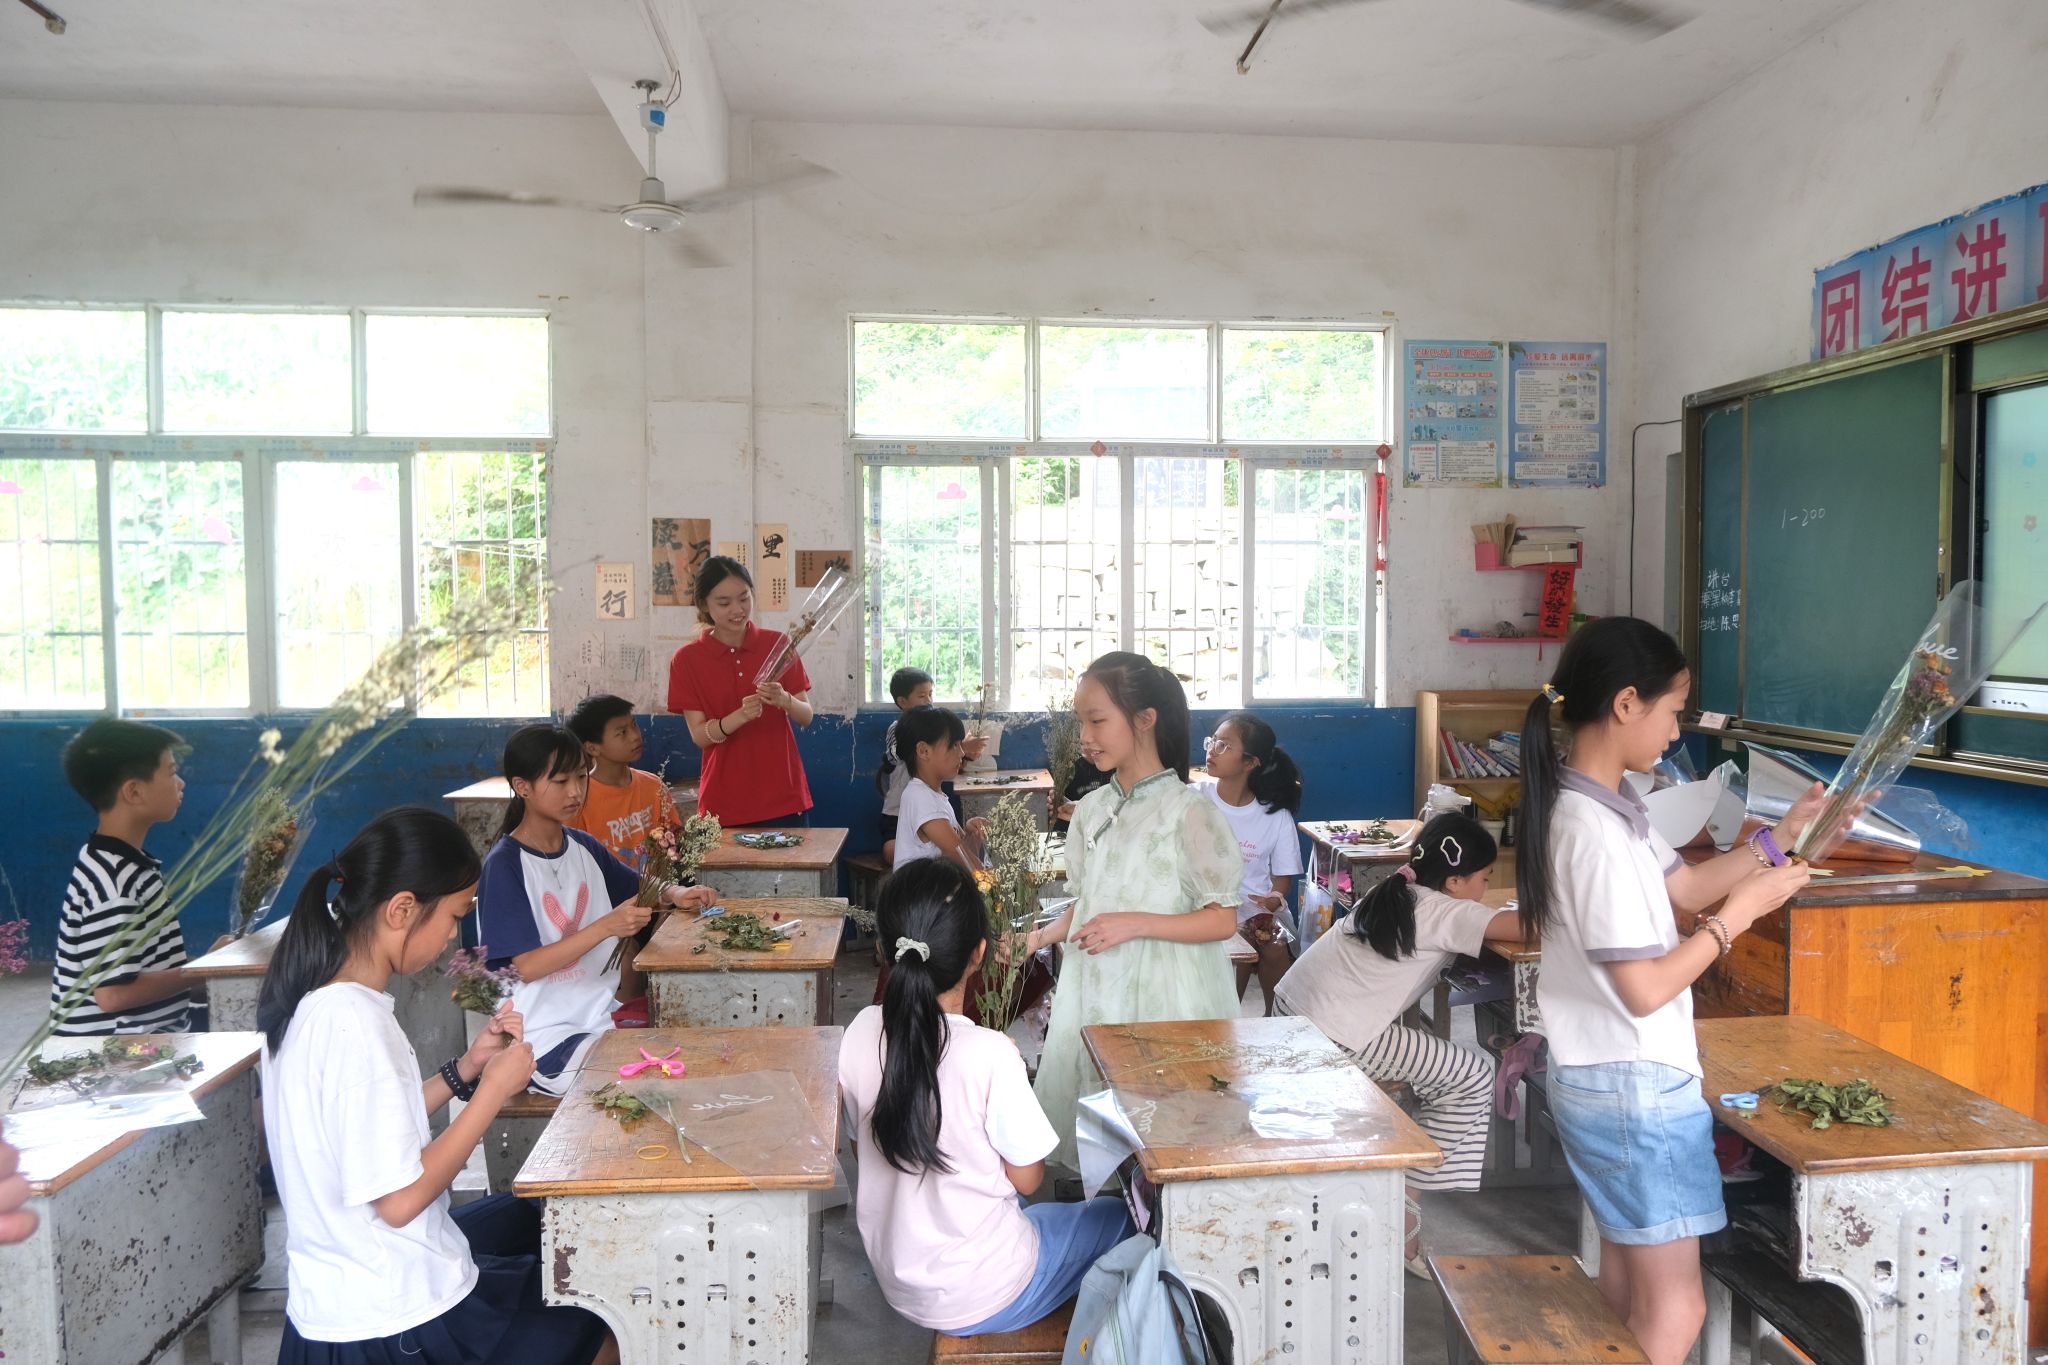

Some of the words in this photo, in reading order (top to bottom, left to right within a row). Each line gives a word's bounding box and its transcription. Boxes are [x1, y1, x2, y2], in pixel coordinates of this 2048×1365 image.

[1820, 201, 2048, 360] 团结讲
[1781, 508, 1826, 529] 1-200
[1707, 568, 1730, 589] 讲台
[600, 588, 628, 618] 行
